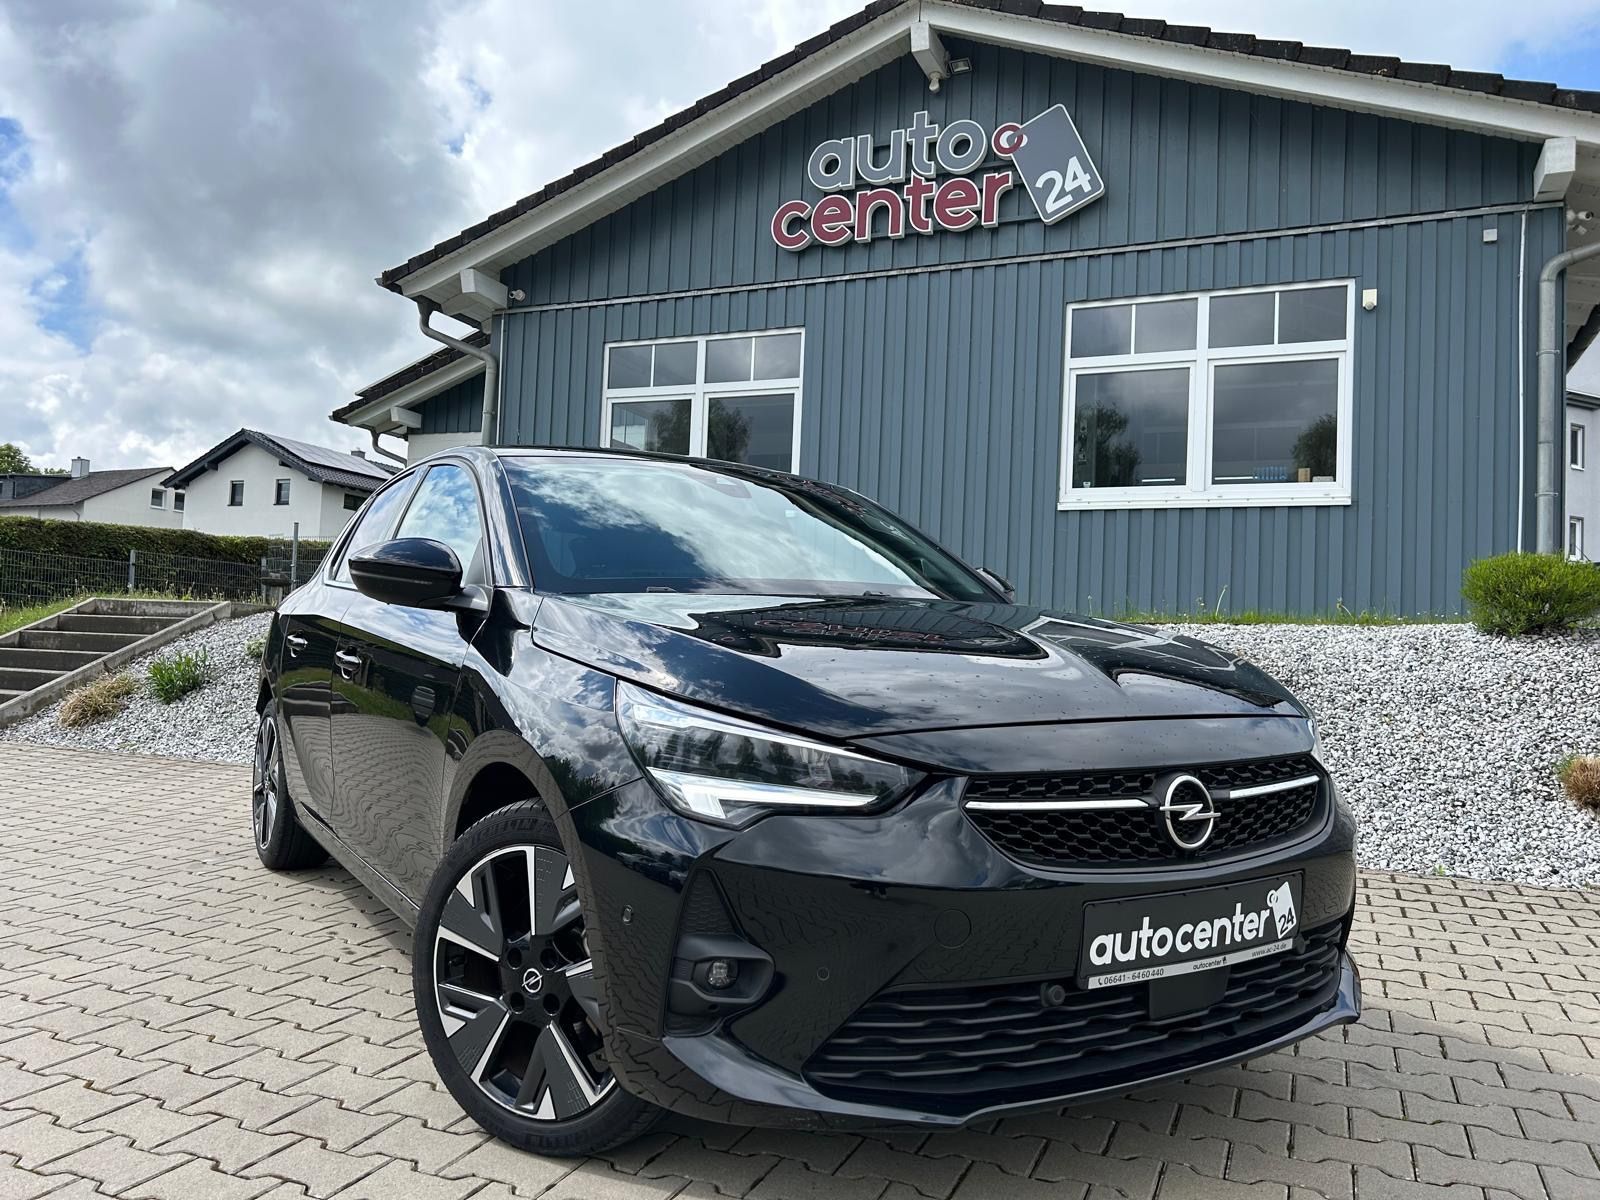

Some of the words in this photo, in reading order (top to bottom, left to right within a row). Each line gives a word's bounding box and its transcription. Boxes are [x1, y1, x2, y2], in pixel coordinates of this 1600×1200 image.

[808, 110, 988, 191] auto
[771, 171, 1013, 251] center
[1035, 156, 1091, 213] 24
[1090, 903, 1269, 966] autocenter
[1279, 908, 1294, 934] 24
[1192, 959, 1222, 970] autocenter
